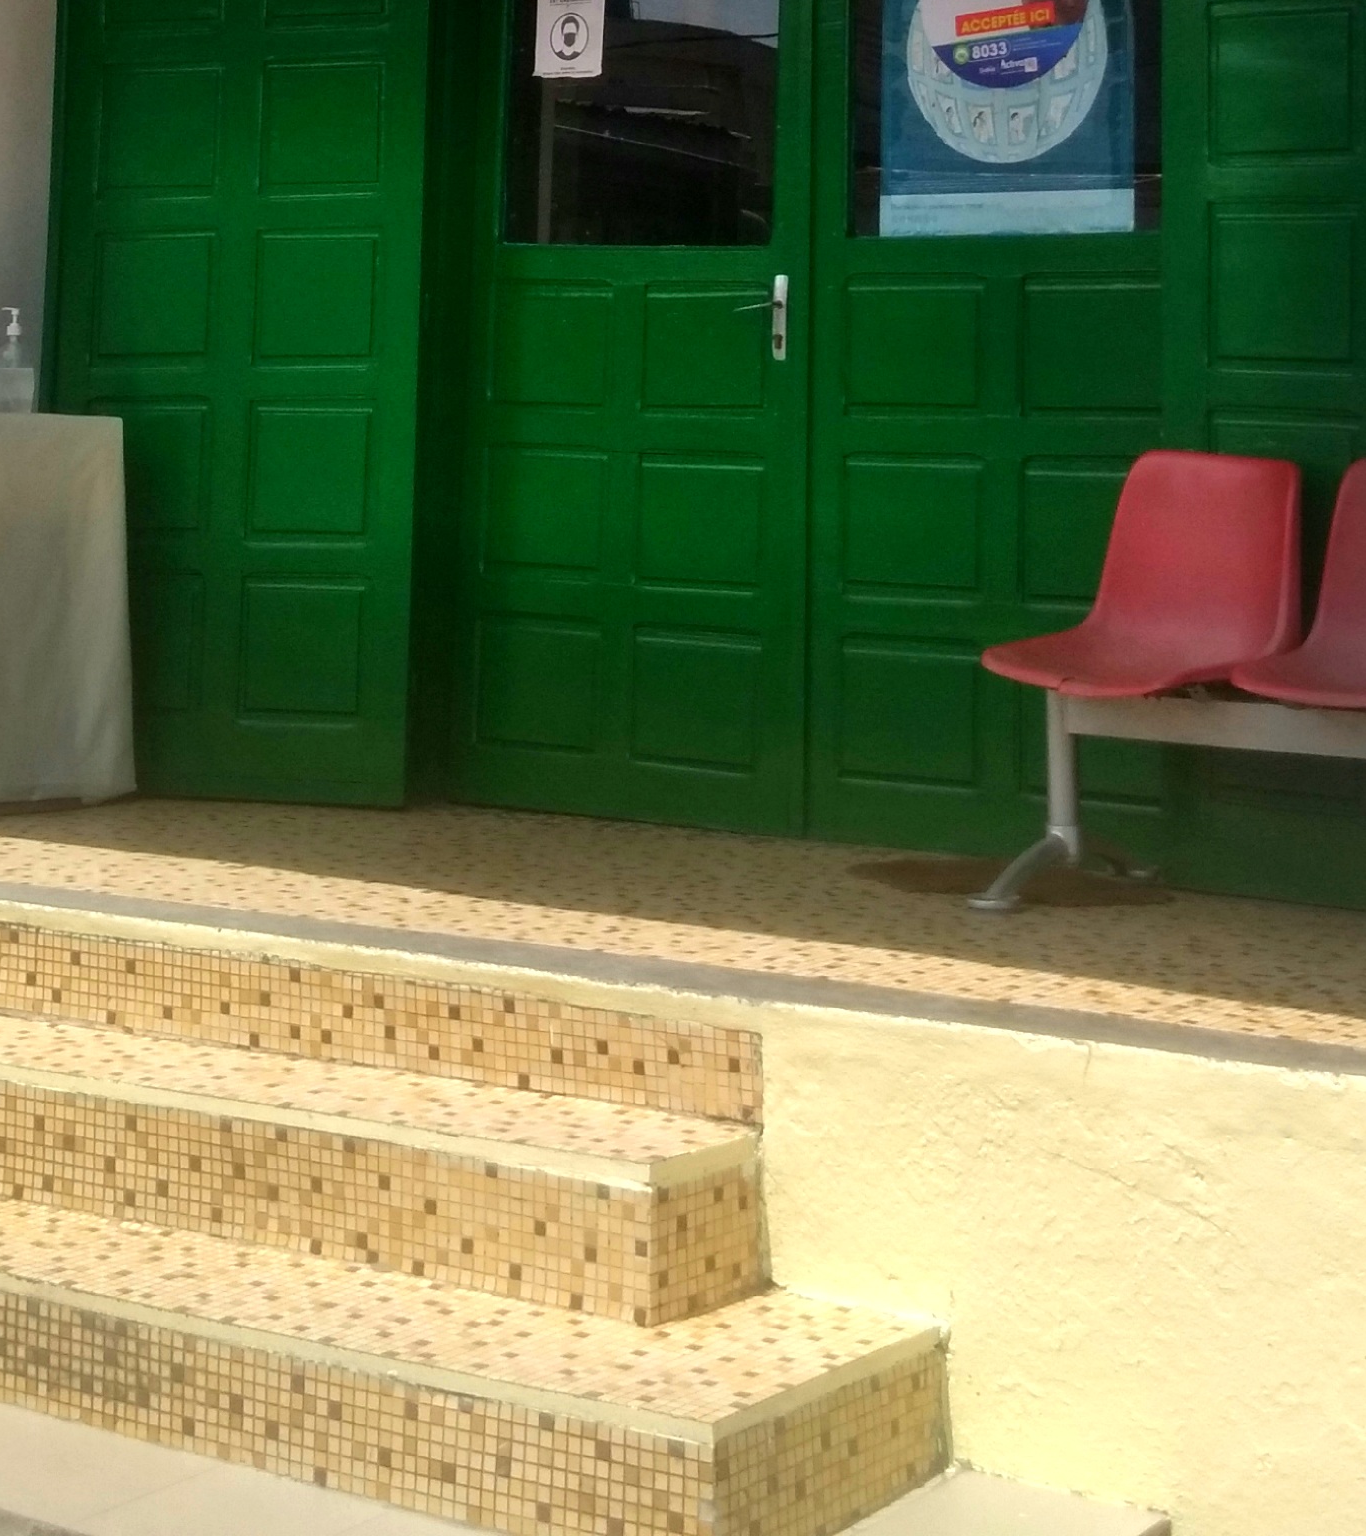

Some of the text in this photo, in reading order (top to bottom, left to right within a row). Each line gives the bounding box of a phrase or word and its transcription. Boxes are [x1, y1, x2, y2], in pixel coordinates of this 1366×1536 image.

[960, 9, 1050, 34] ACCEPTÉE ICI
[971, 41, 1008, 60] 8033
